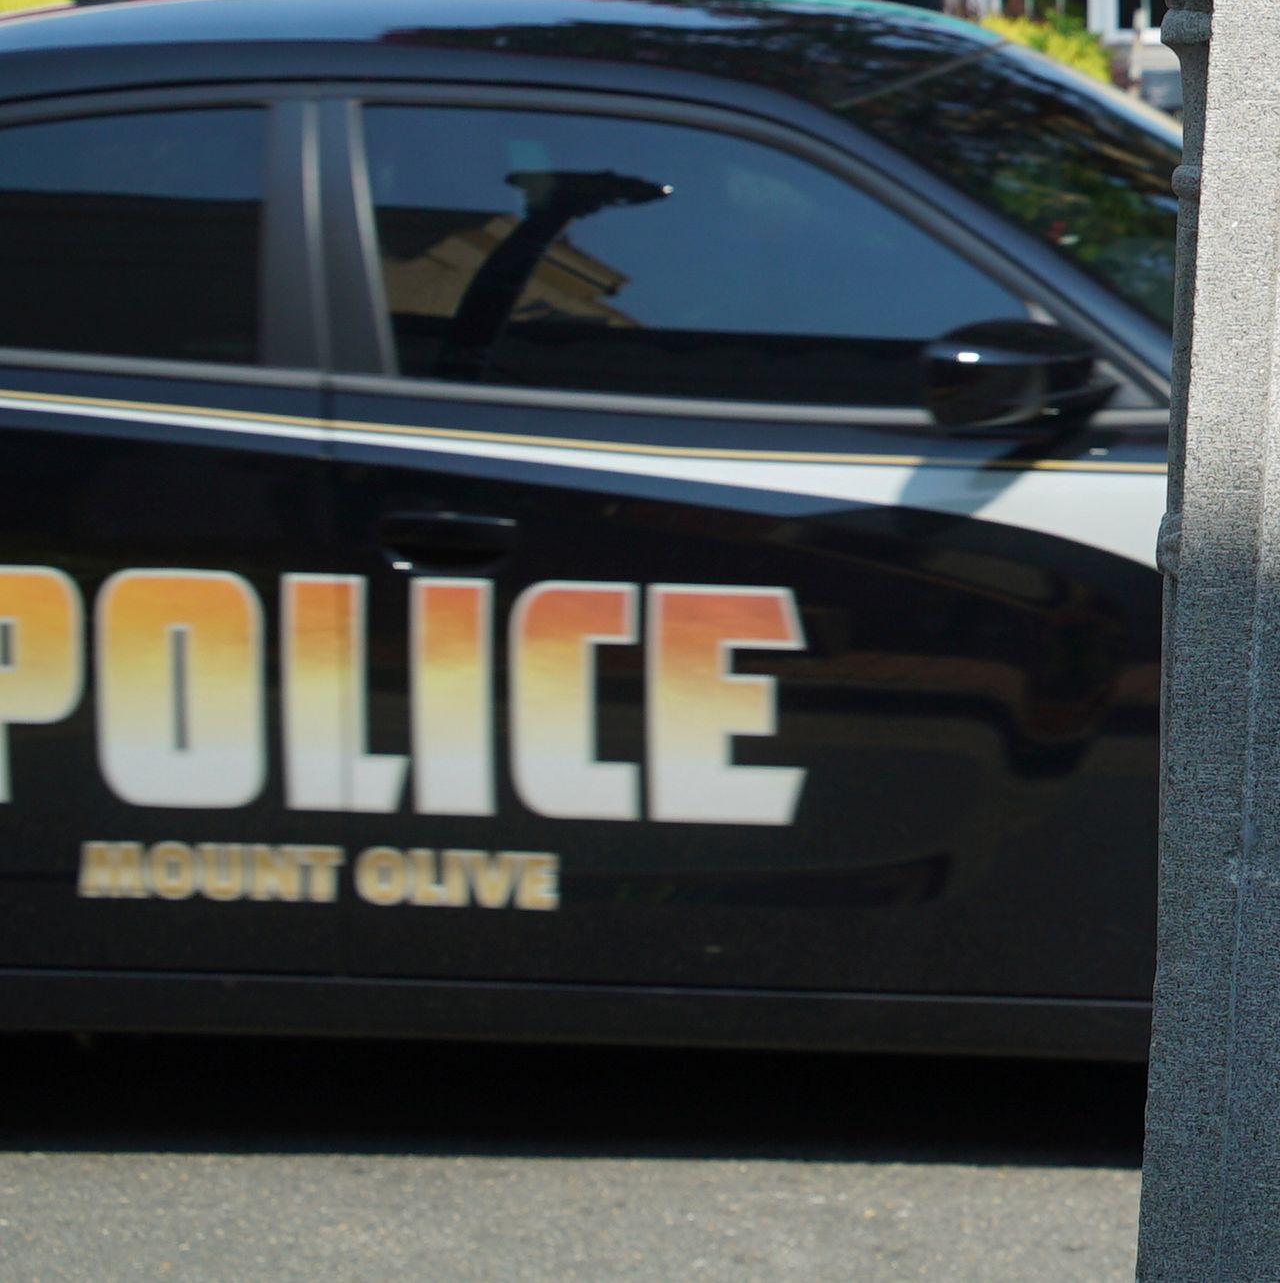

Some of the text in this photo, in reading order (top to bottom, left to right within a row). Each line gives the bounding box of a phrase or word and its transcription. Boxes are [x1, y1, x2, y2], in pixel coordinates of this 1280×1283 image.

[0, 563, 808, 827] POLICE
[77, 840, 562, 912] MOUNT OLIVE
